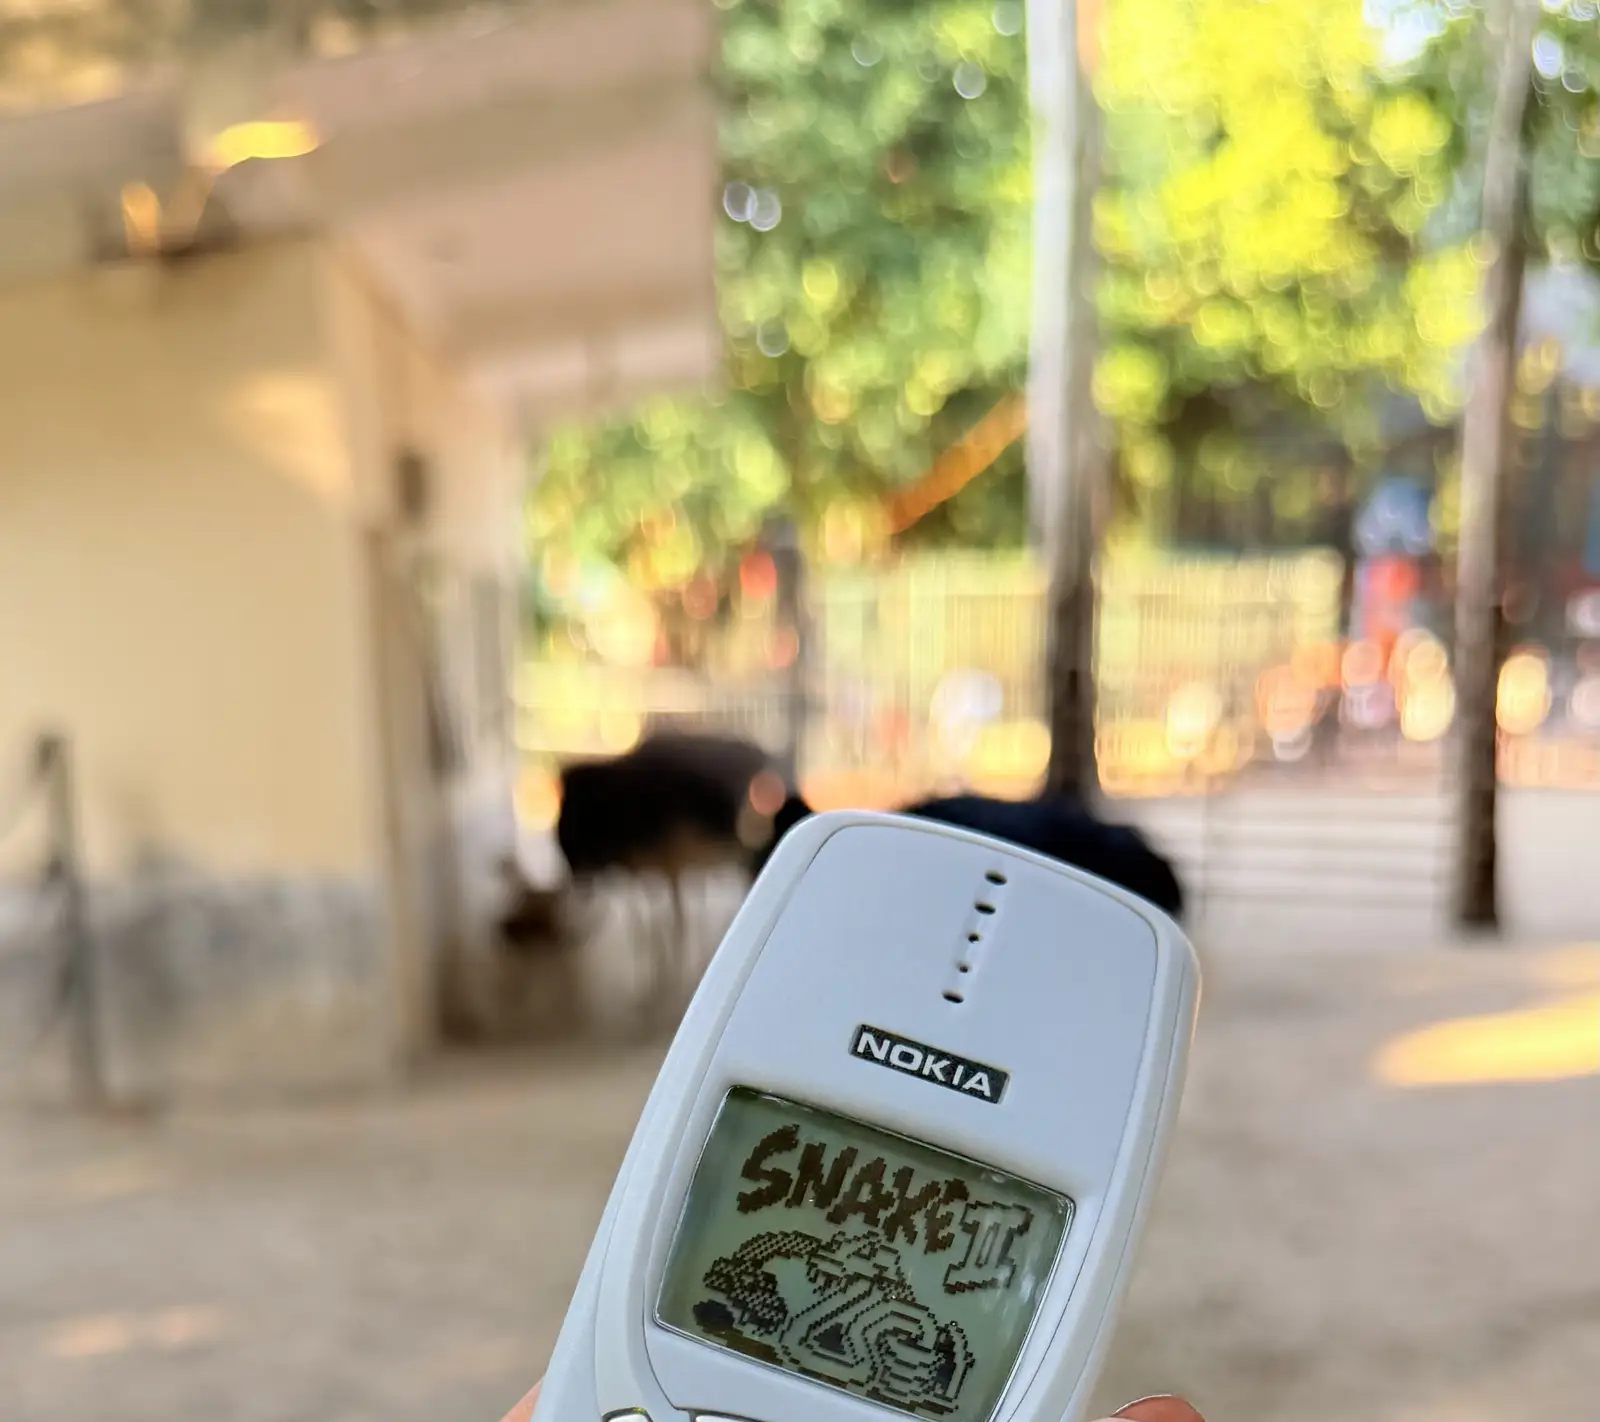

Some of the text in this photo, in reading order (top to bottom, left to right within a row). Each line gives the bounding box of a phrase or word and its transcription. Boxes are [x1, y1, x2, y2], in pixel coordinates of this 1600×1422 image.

[857, 1032, 992, 1097] NOKIA
[736, 1123, 1034, 1294] SNAKE II
